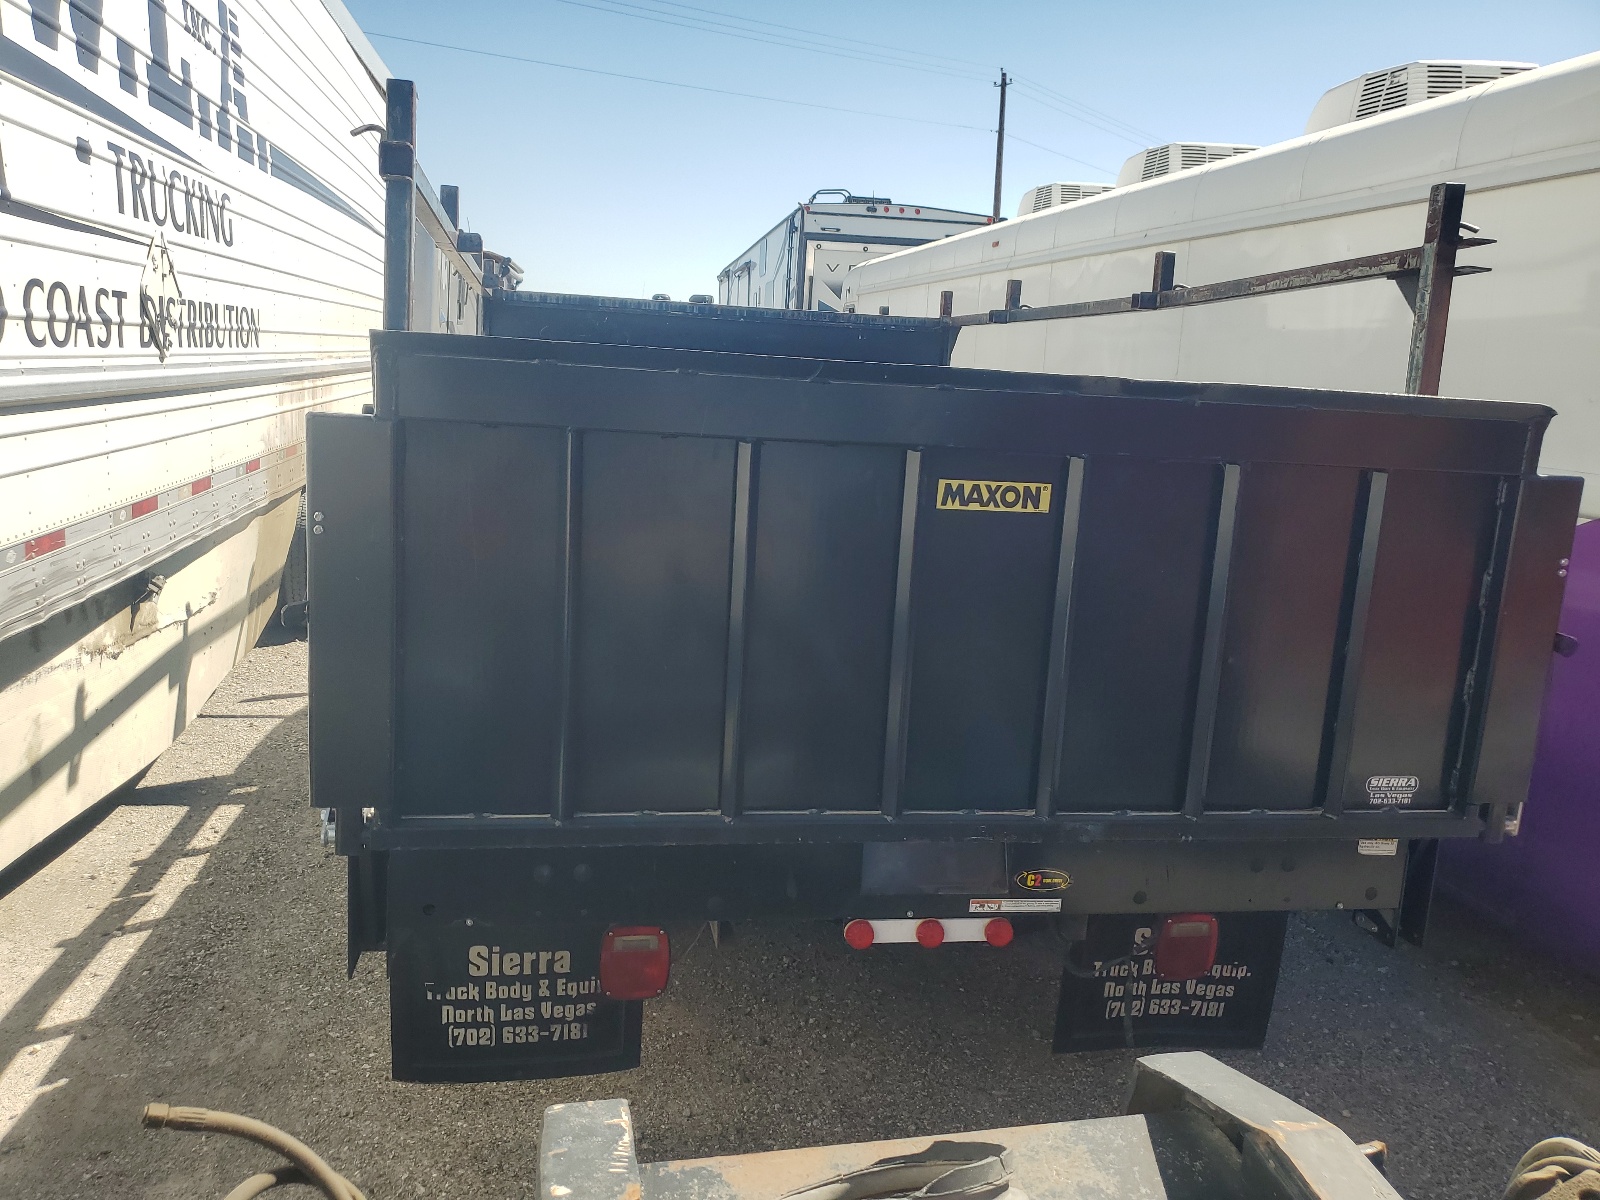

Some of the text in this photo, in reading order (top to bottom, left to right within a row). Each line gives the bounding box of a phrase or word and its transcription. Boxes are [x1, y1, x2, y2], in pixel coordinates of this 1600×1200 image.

[107, 141, 234, 247] TRUCKING
[23, 278, 128, 348] COAST
[139, 295, 261, 349] DISTRIBUTION
[940, 482, 1042, 510] MAXON
[1369, 777, 1416, 787] SIERRA
[468, 945, 571, 977] Sierra
[1094, 961, 1140, 978] Tuck
[1204, 961, 1252, 980] quip.
[425, 982, 480, 1001] uck
[485, 981, 532, 1002] Body
[538, 979, 551, 997] &
[1103, 978, 1235, 1000] Noth Las Vegas
[441, 1001, 597, 1024] North Las Vegas
[1149, 999, 1226, 1019] 633-7181
[448, 1022, 588, 1047] (702) 633-7181
